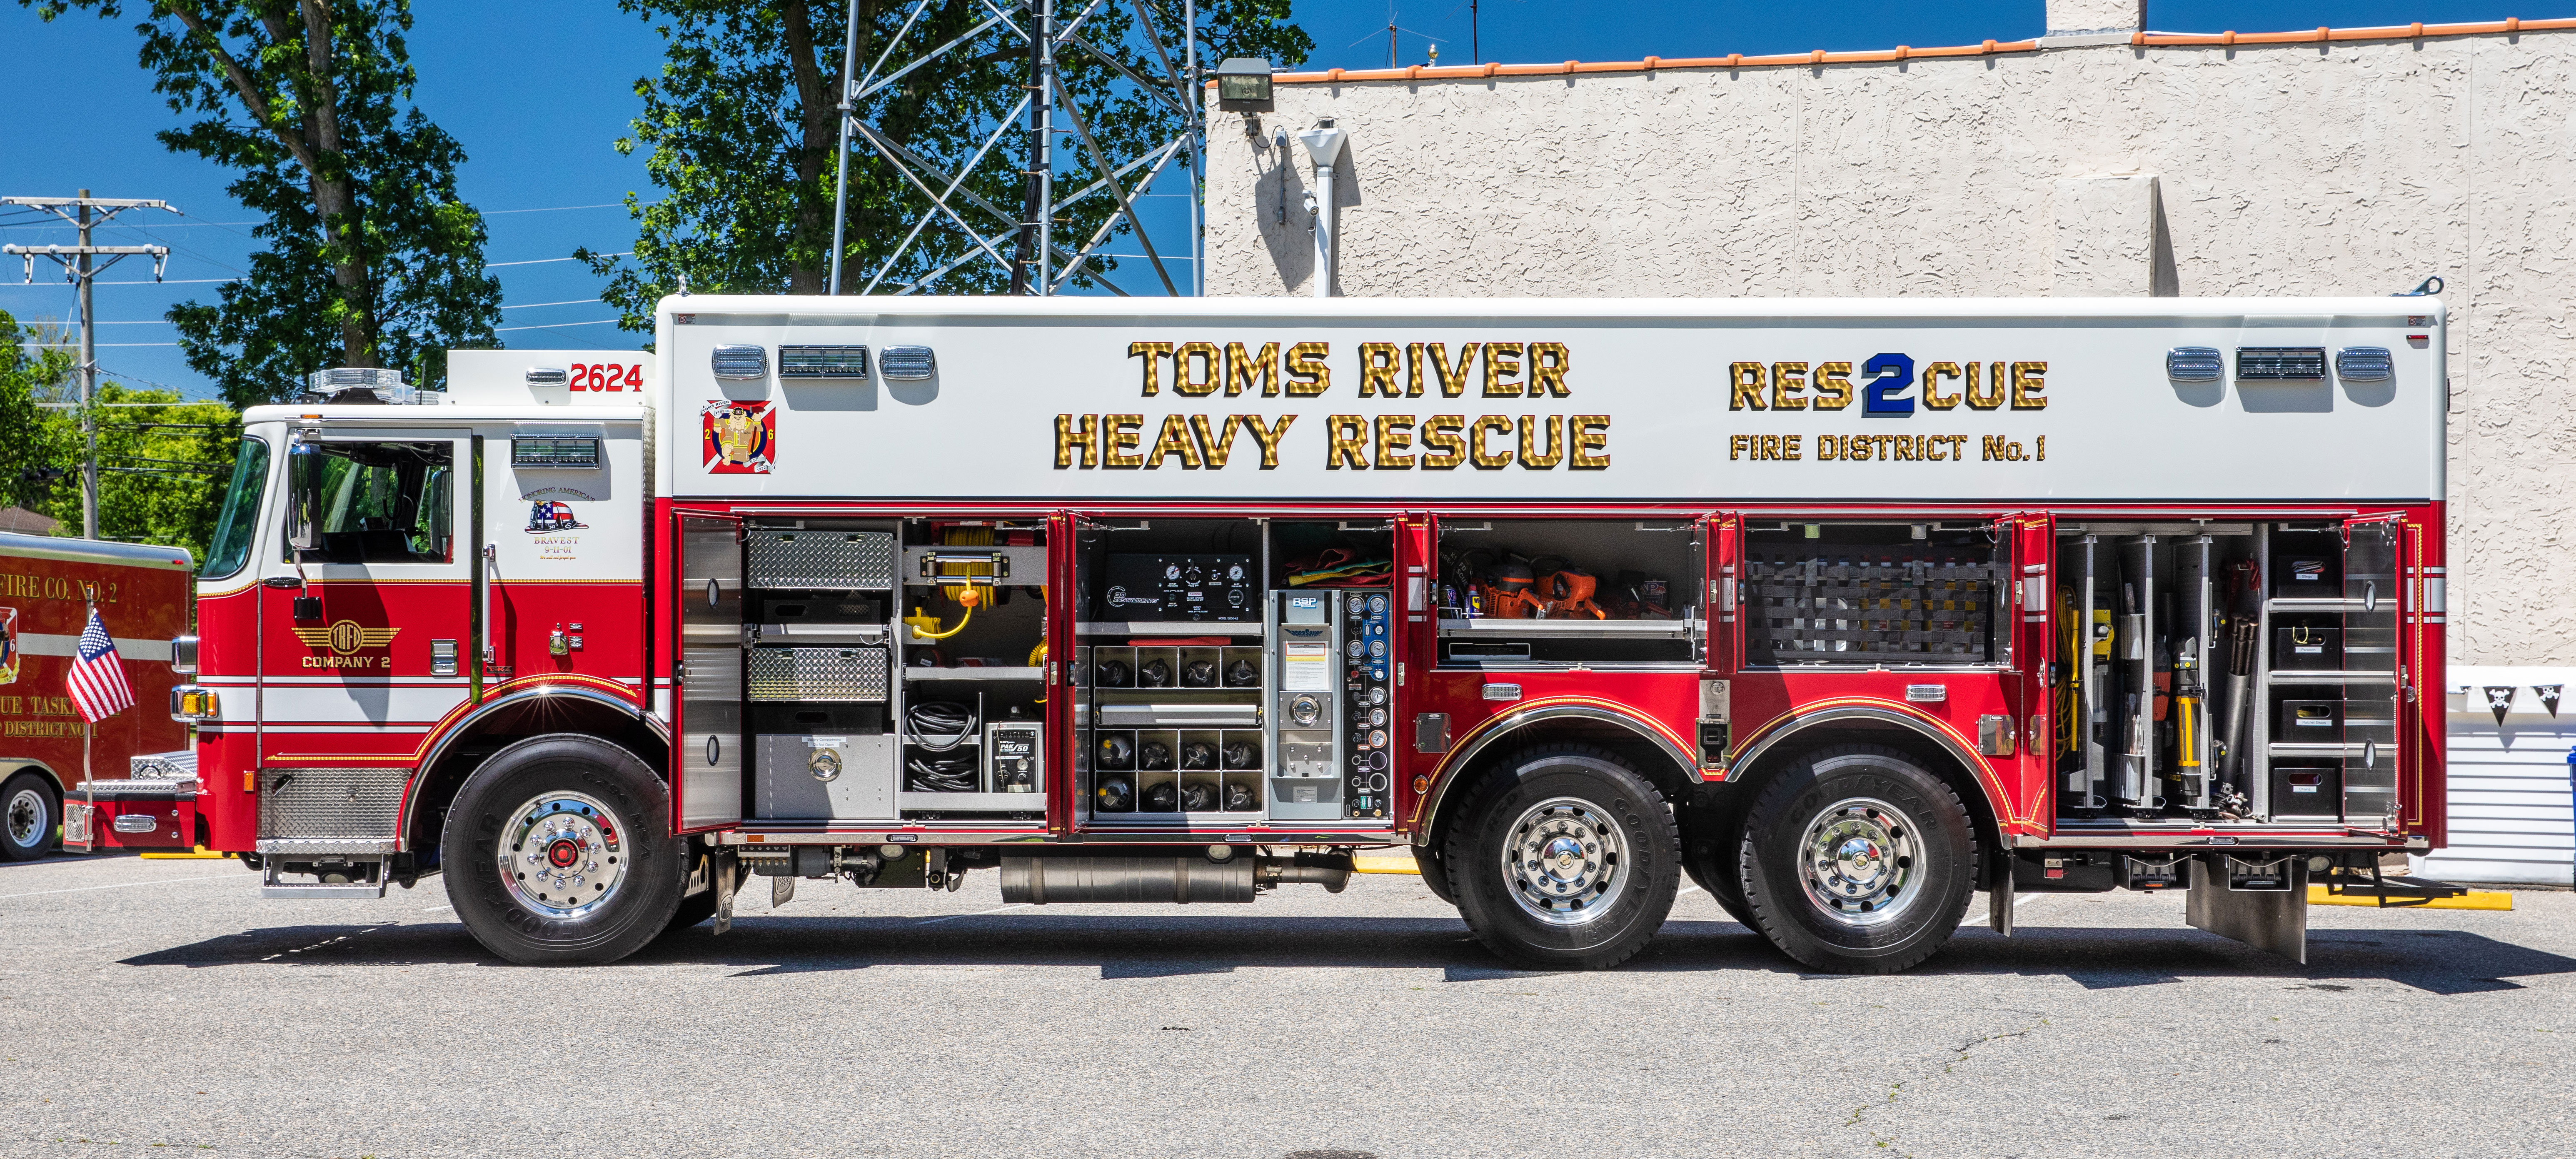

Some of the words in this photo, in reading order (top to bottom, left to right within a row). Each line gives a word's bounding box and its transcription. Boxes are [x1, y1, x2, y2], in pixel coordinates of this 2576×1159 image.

[569, 363, 644, 392] 2624
[1128, 342, 1330, 398] TOMS
[1358, 342, 1571, 398] RIVER
[705, 429, 711, 440] 2
[768, 429, 774, 440] 6
[1053, 414, 1298, 470] HEAVY
[1326, 415, 1610, 470] RESCUE
[1730, 435, 1802, 461] FIRE
[1817, 435, 1968, 461] DISTRICT
[518, 487, 556, 503] HONORING
[558, 487, 595, 503] AMERICA'S
[45, 577, 71, 601] CO.
[77, 580, 104, 603] NO.
[110, 583, 117, 603] 2
[1293, 597, 1317, 607] RSP
[10, 639, 15, 652] 6
[333, 624, 361, 650] TRFD
[302, 657, 374, 668] COMPANY
[381, 657, 390, 668] 2
[4, 721, 63, 737] DISTRICT
[92, 723, 97, 738] 1
[1791, 774, 1938, 831] GOODYEAR
[1585, 797, 1652, 944] GOODYEAR
